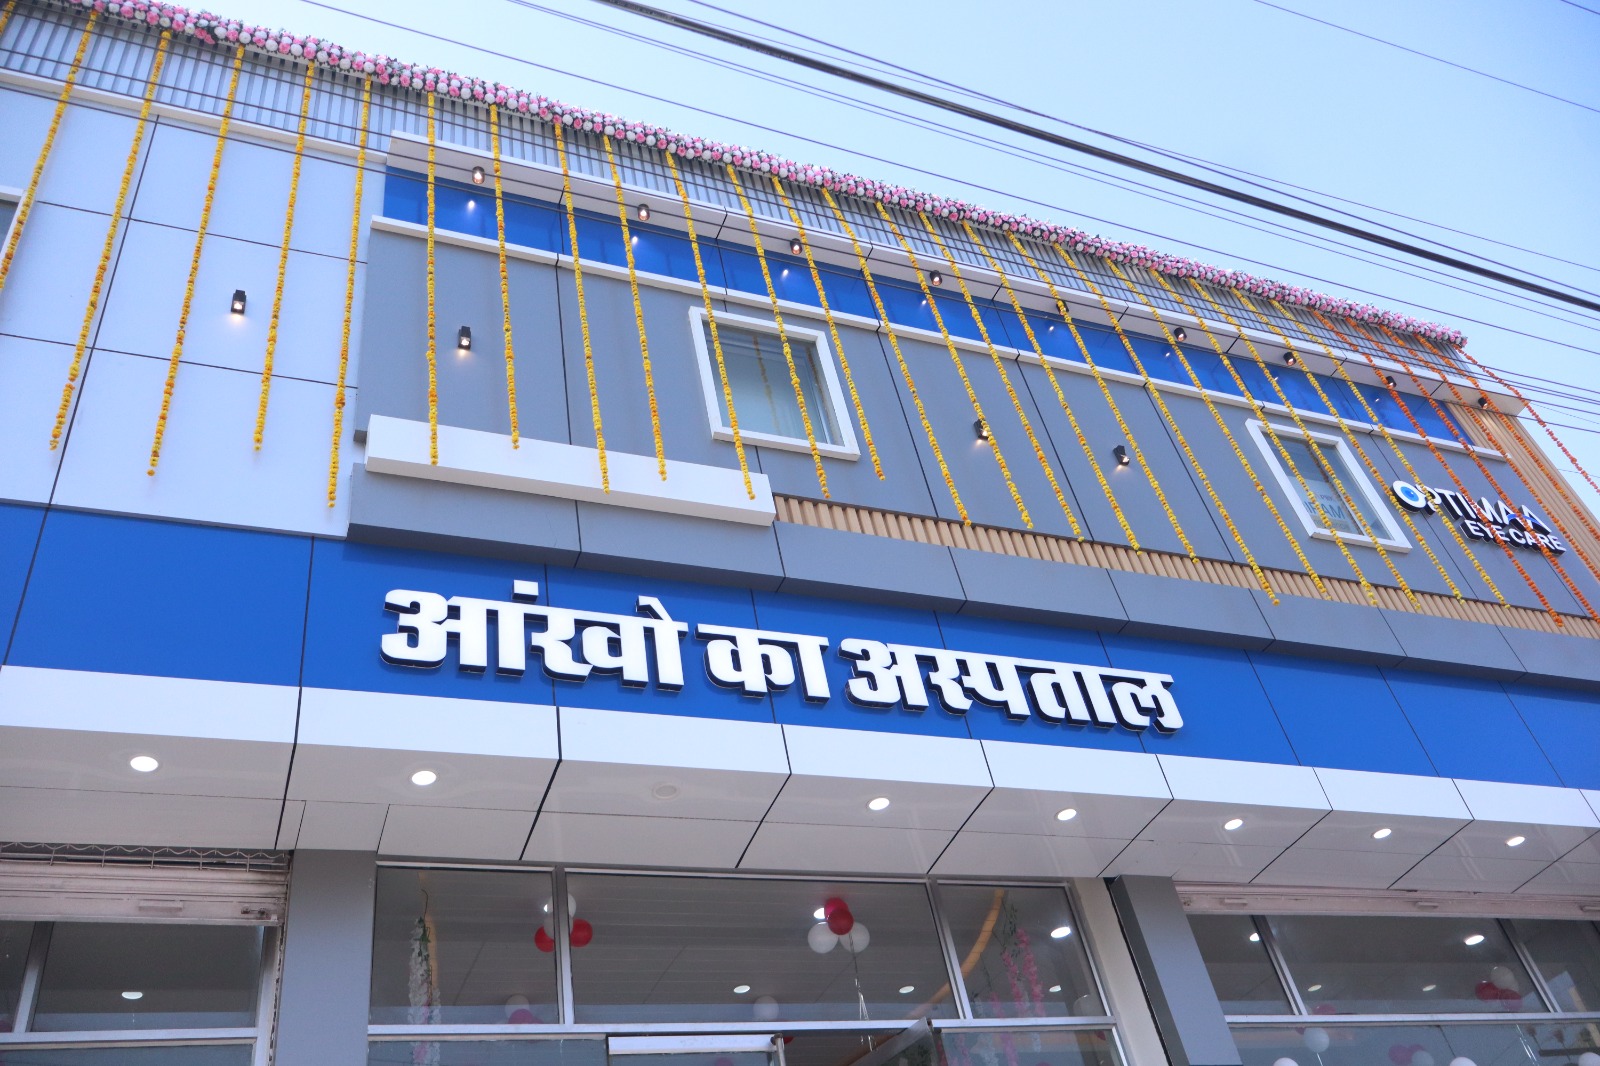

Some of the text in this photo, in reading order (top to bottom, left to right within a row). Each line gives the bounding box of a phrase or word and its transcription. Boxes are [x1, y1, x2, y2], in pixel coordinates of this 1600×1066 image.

[1392, 480, 1552, 534] OPTIMAA
[1464, 519, 1567, 552] EYE CARE
[381, 579, 1183, 733] आंखो का अस्पताल
